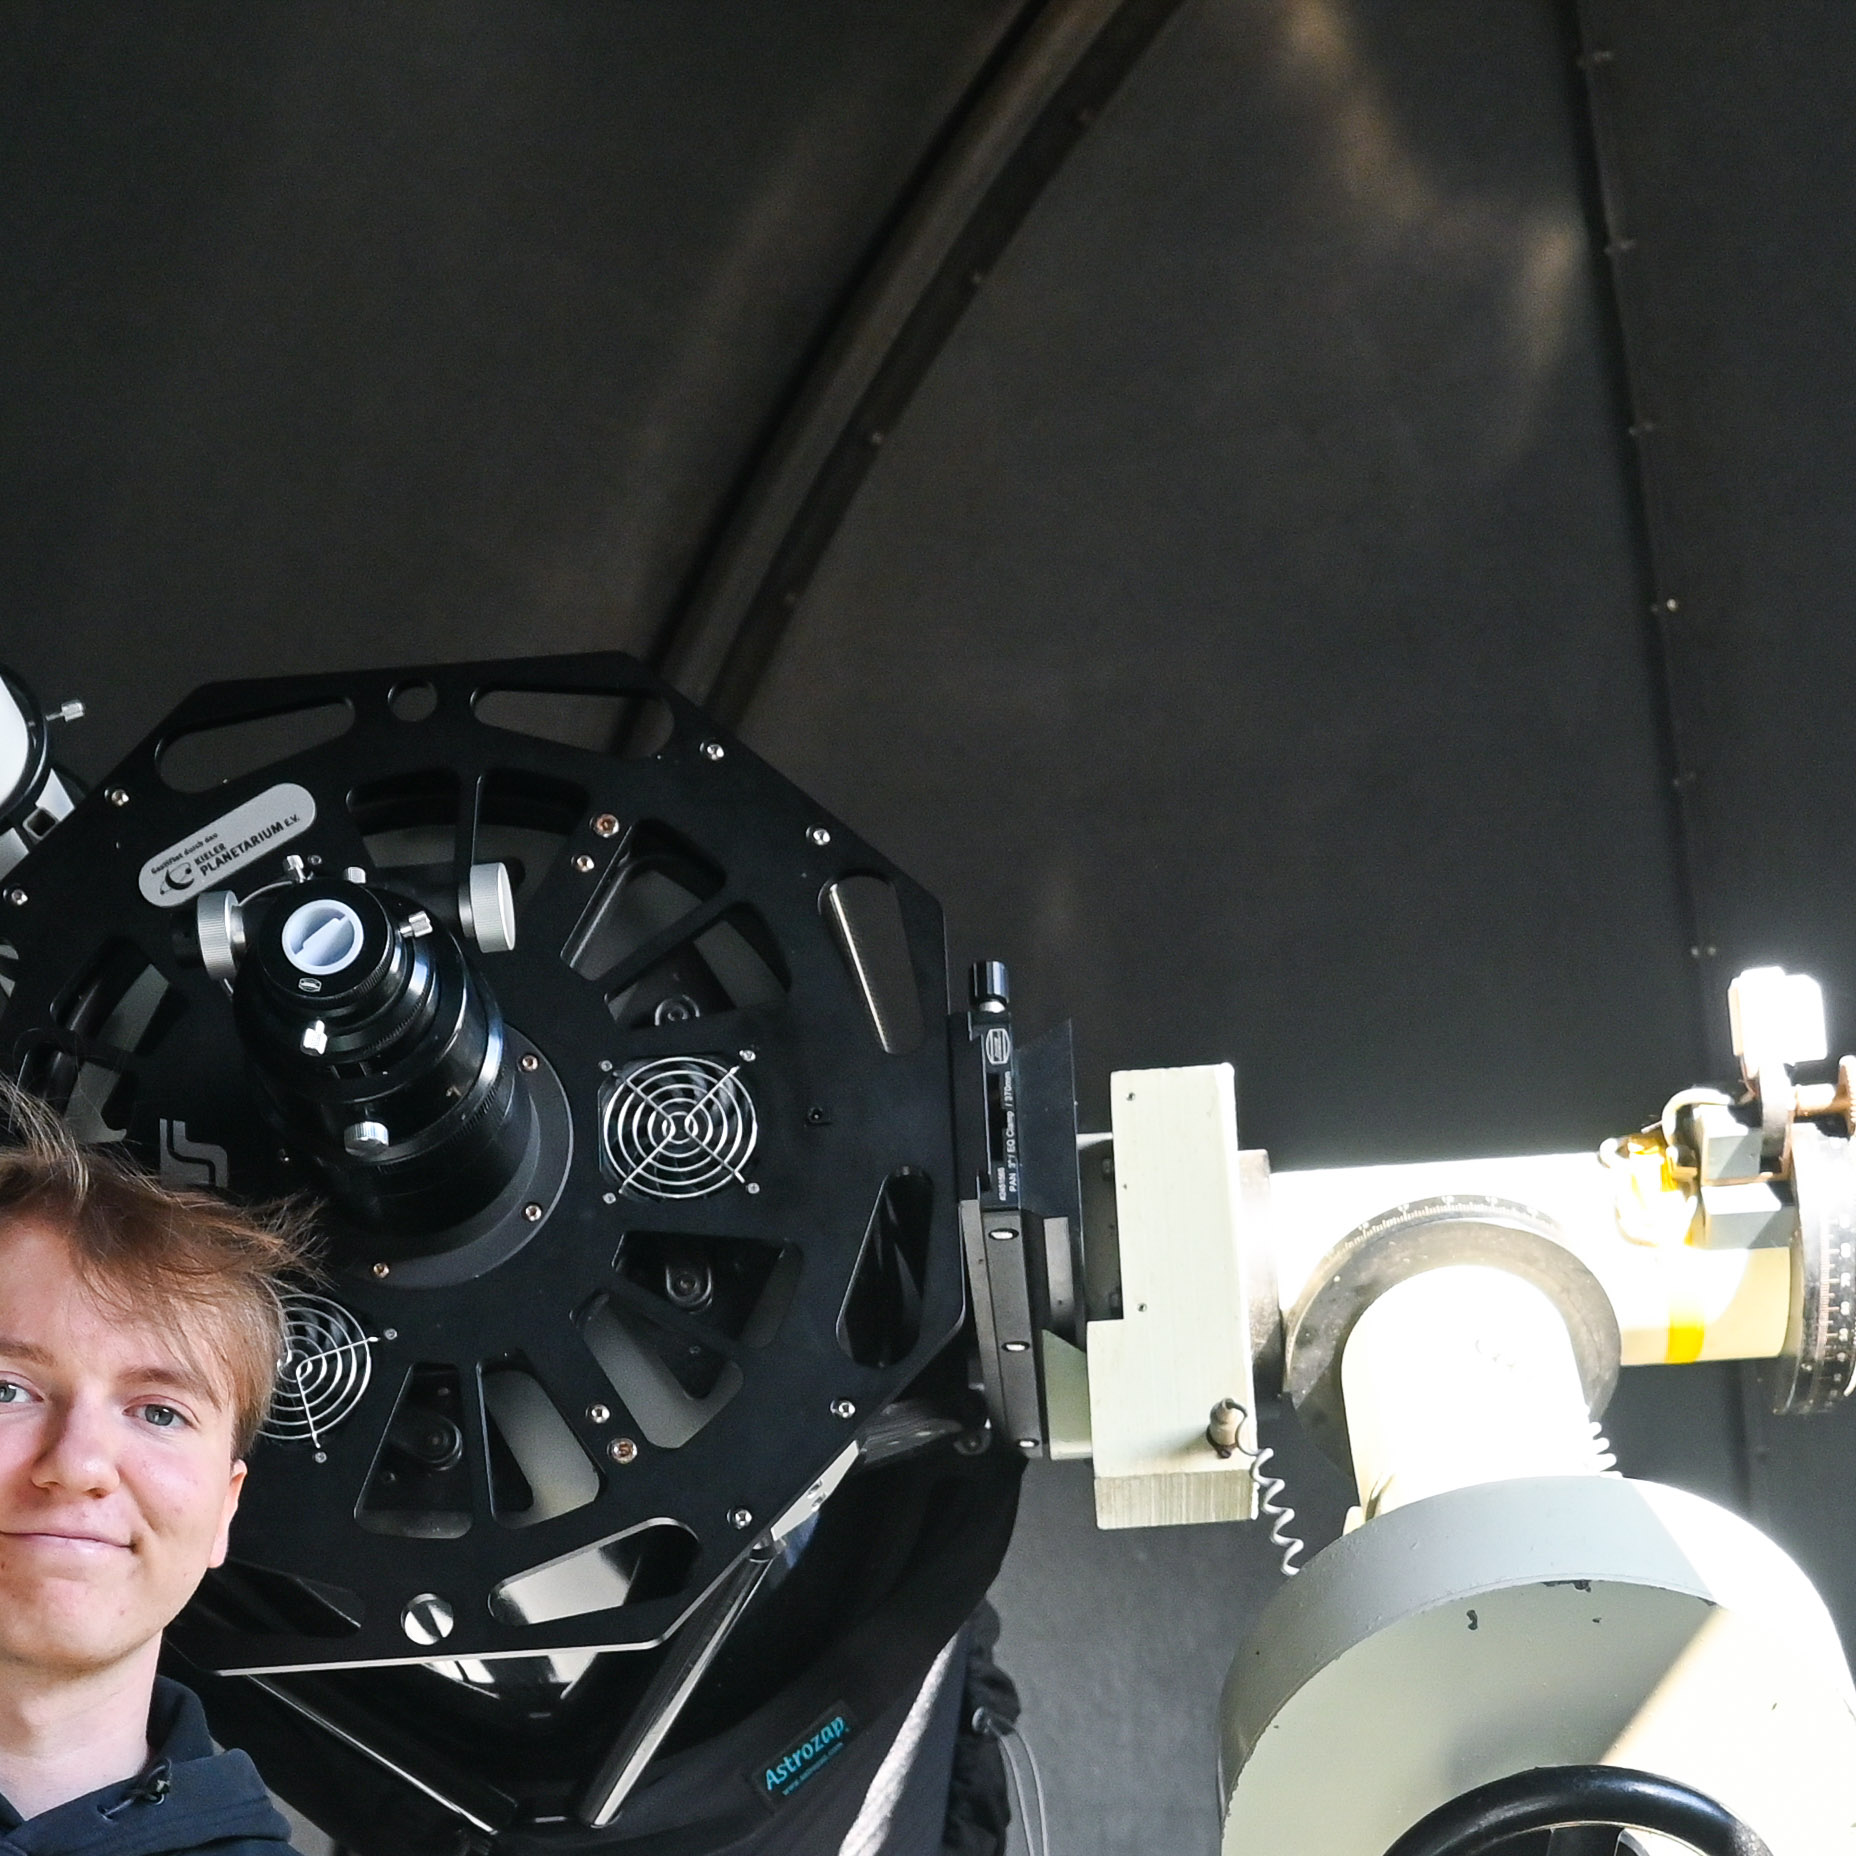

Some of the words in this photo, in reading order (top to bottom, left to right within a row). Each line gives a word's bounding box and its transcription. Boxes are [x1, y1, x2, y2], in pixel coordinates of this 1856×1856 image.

[184, 840, 205, 857] durch
[194, 843, 227, 866] KIELER
[199, 821, 284, 876] PLANETARIUM
[1004, 1071, 1013, 1101] 370mm
[1005, 1110, 1016, 1138] Clamp
[1006, 1138, 1017, 1154] EQ
[1008, 1172, 1018, 1193] PAN
[766, 1716, 845, 1791] Astrozap
